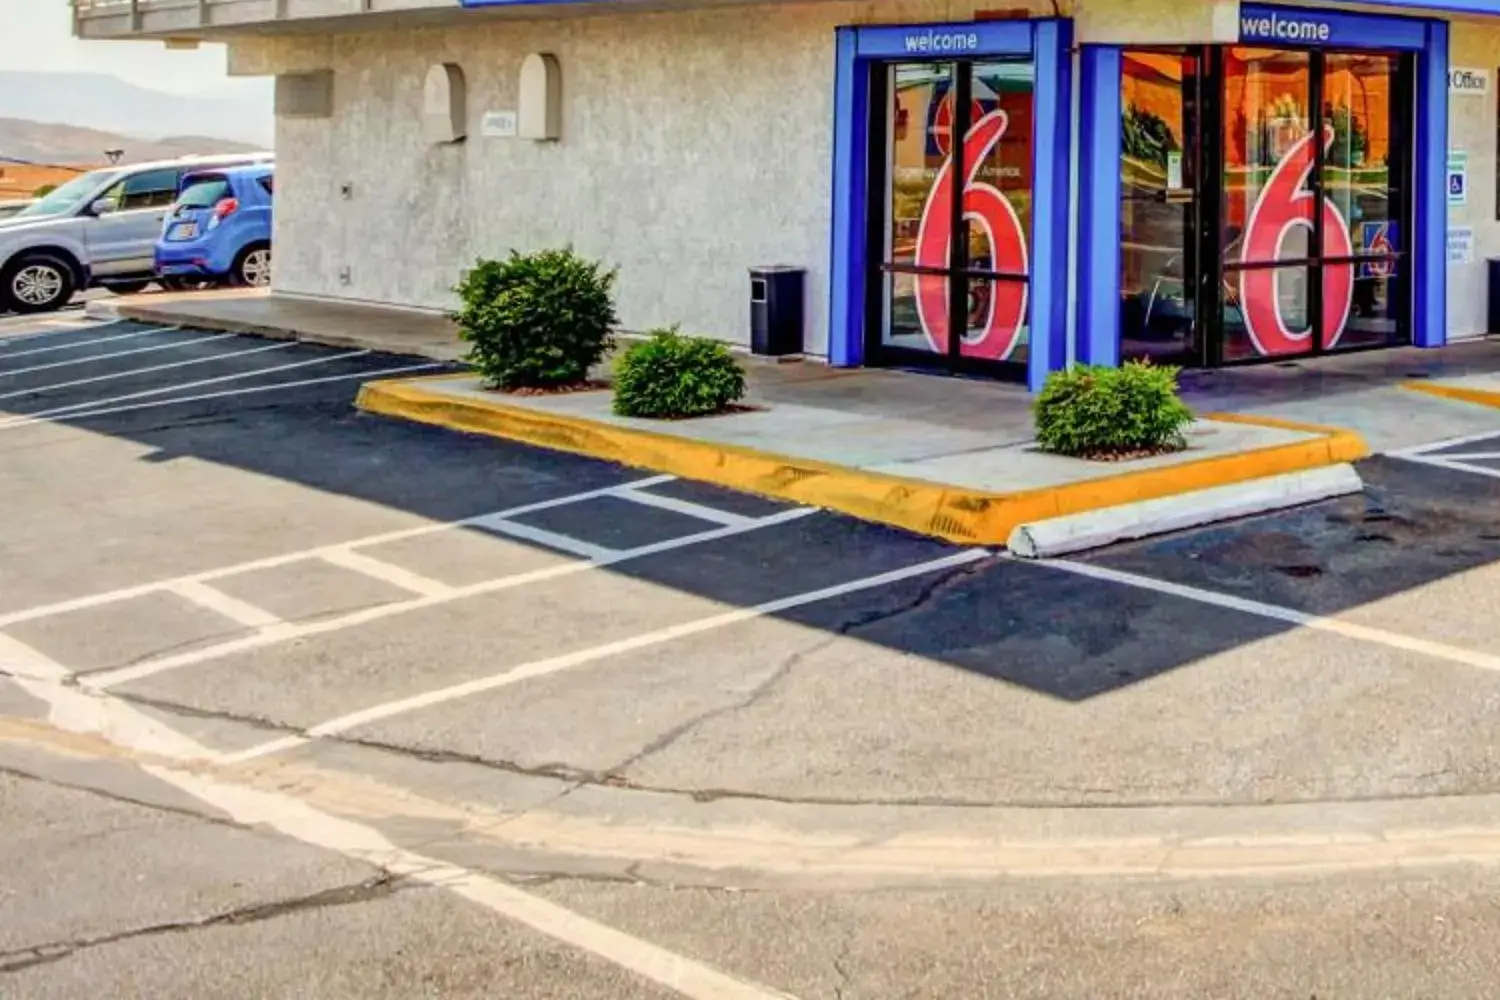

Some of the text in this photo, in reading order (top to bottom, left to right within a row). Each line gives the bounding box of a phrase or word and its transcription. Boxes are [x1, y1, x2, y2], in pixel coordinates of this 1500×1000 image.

[905, 28, 977, 52] welcome
[1241, 12, 1329, 40] welcome
[914, 109, 1028, 361] 6
[1241, 120, 1354, 355] 6
